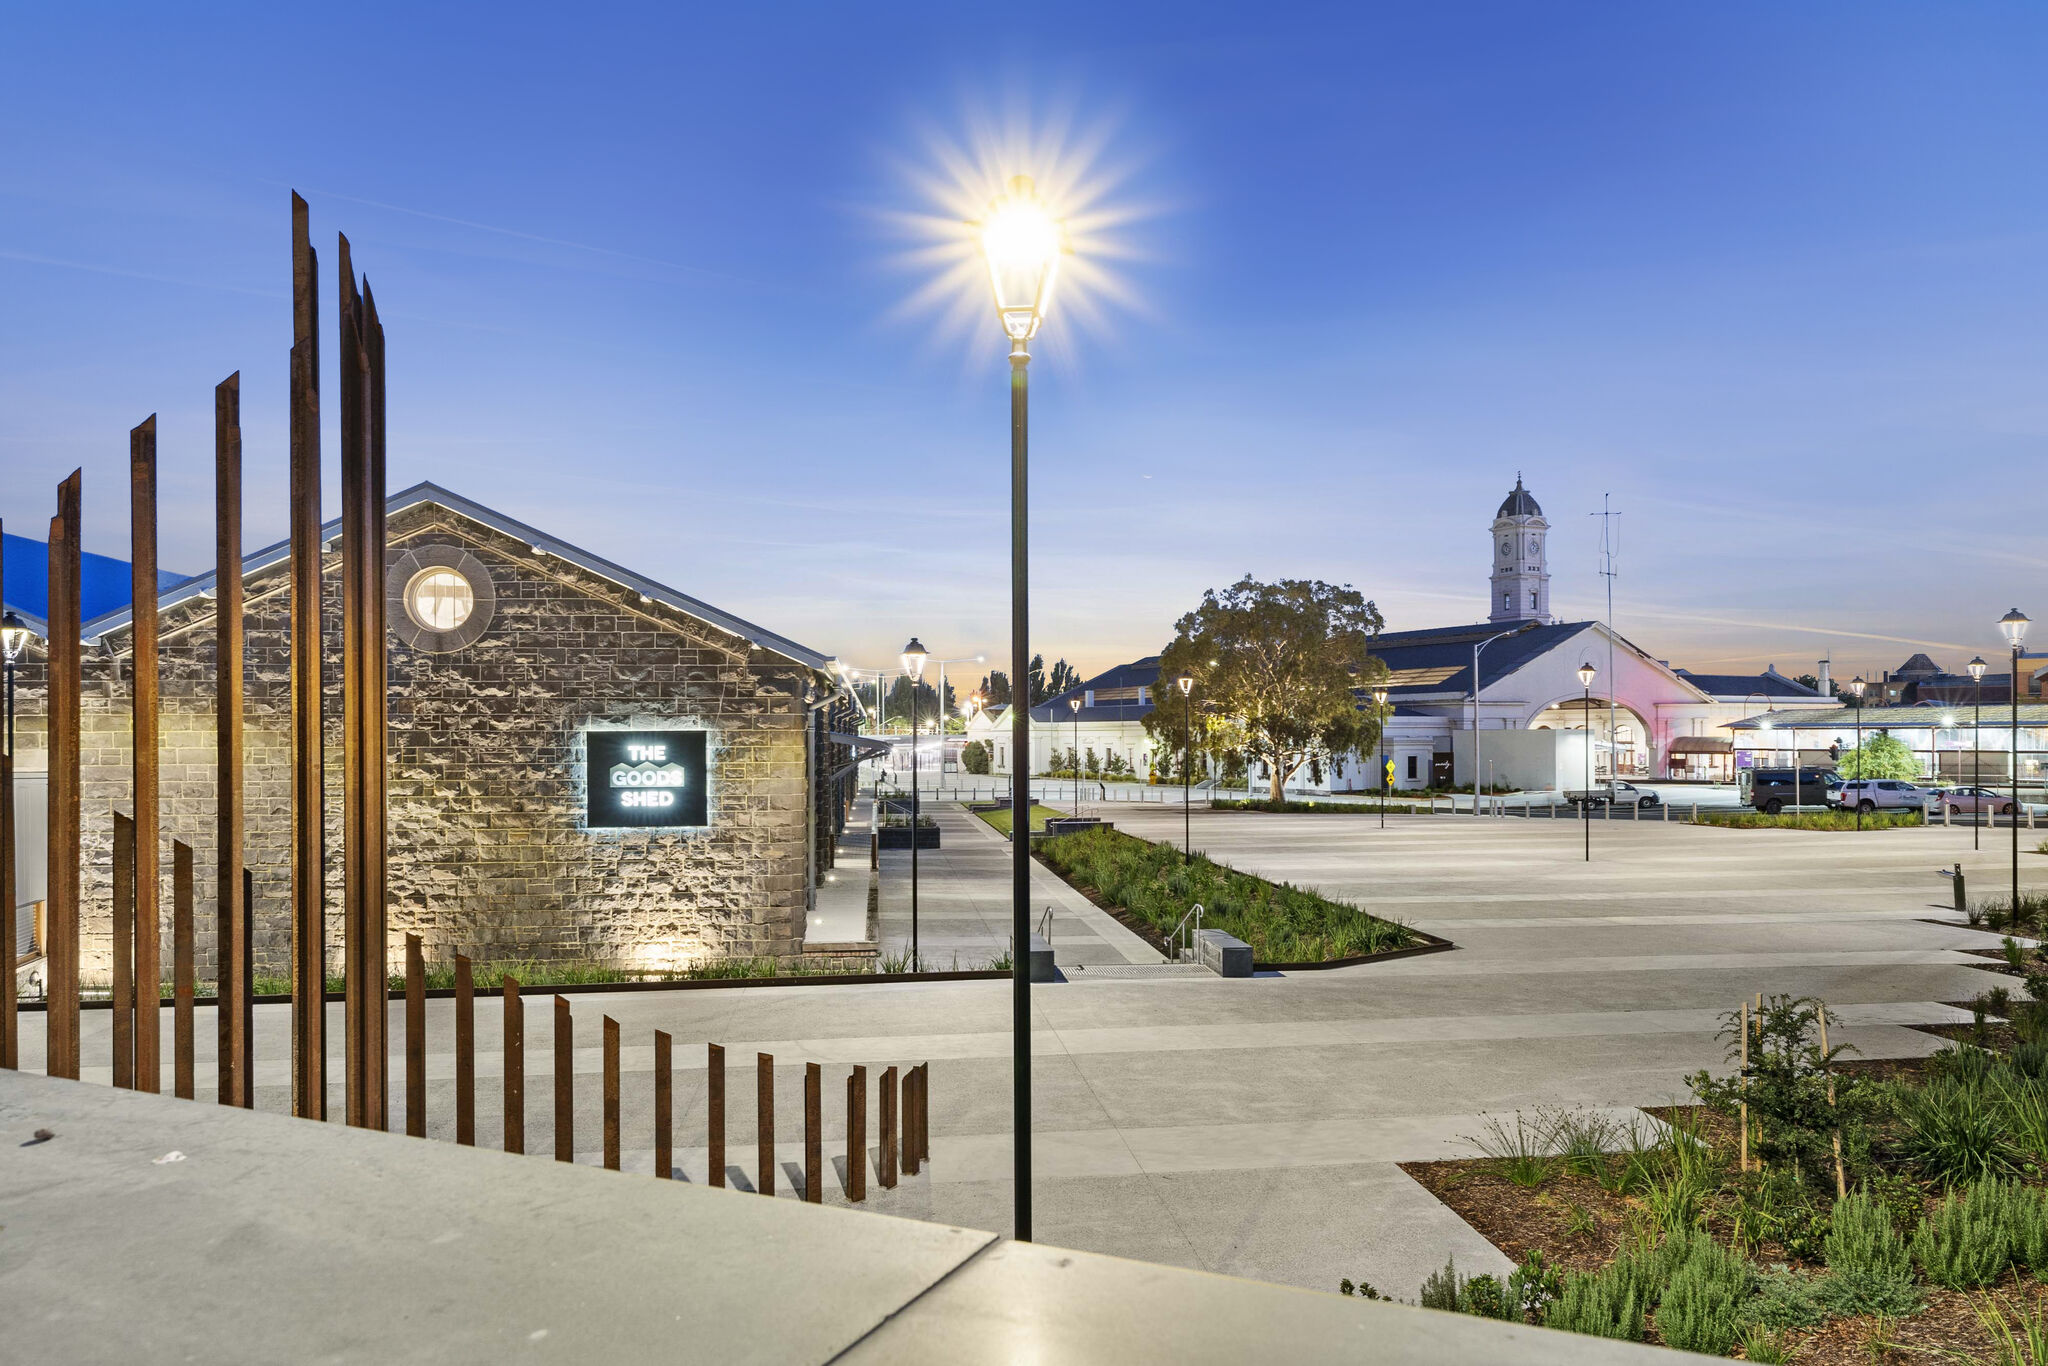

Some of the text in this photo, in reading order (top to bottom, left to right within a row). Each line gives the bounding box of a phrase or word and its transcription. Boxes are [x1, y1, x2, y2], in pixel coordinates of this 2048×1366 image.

[627, 745, 666, 761] THE
[612, 770, 682, 786] GOODS
[621, 791, 674, 807] SHED
